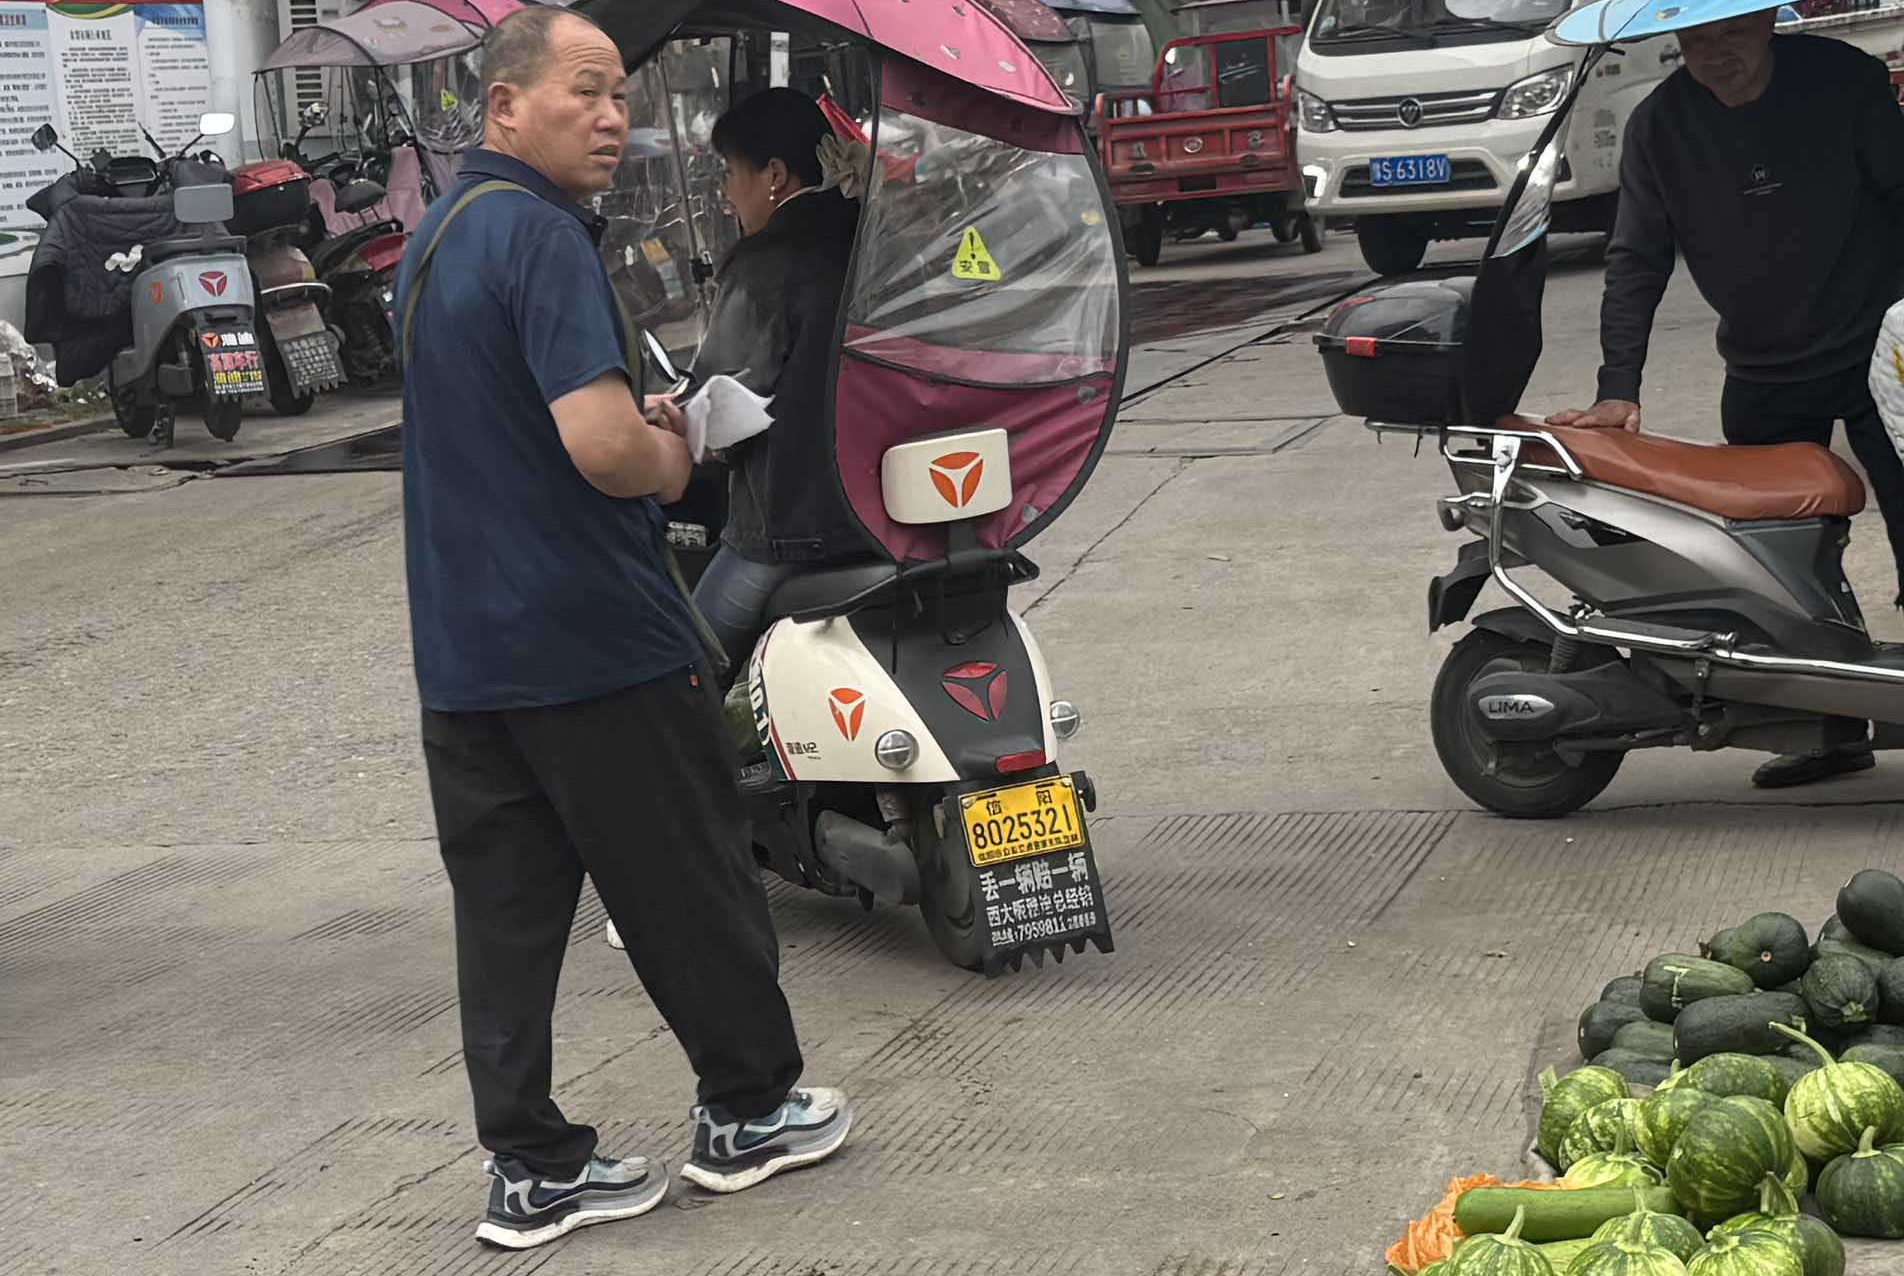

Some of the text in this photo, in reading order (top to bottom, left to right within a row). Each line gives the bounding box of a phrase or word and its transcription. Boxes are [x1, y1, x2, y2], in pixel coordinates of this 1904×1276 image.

[1488, 699, 1534, 715] LIMA
[986, 789, 1053, 816] 信 阳
[972, 803, 1073, 850] 8025321
[979, 851, 1089, 902] 丢一辆赔一辆
